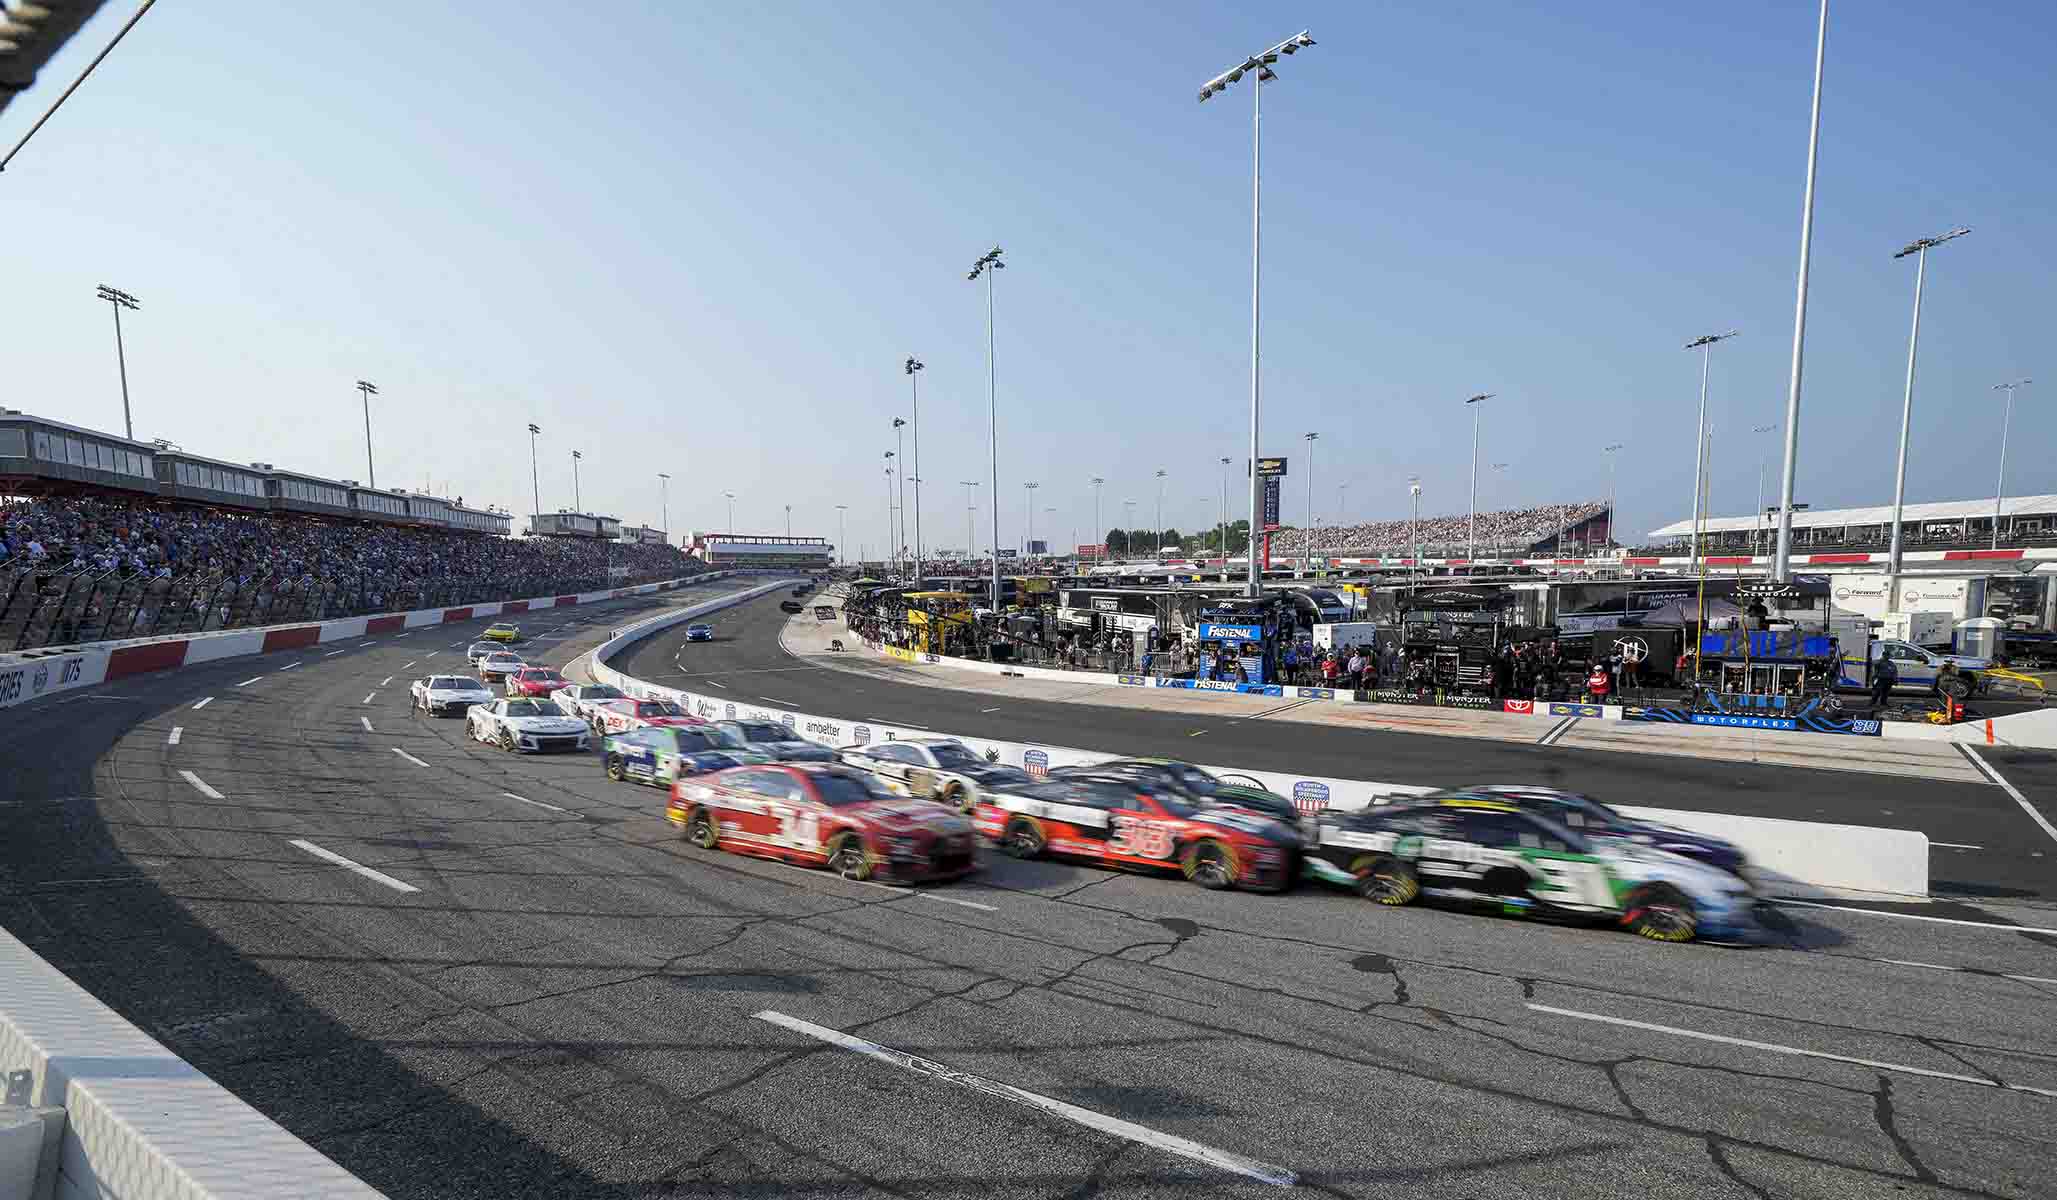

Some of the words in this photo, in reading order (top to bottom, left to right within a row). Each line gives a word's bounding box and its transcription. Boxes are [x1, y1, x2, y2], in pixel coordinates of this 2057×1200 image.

[1208, 625, 1252, 638] FASTENAL
[1194, 678, 1239, 691] FASTENAL
[1446, 696, 1491, 704] MONSTER
[806, 721, 840, 737] ambetter
